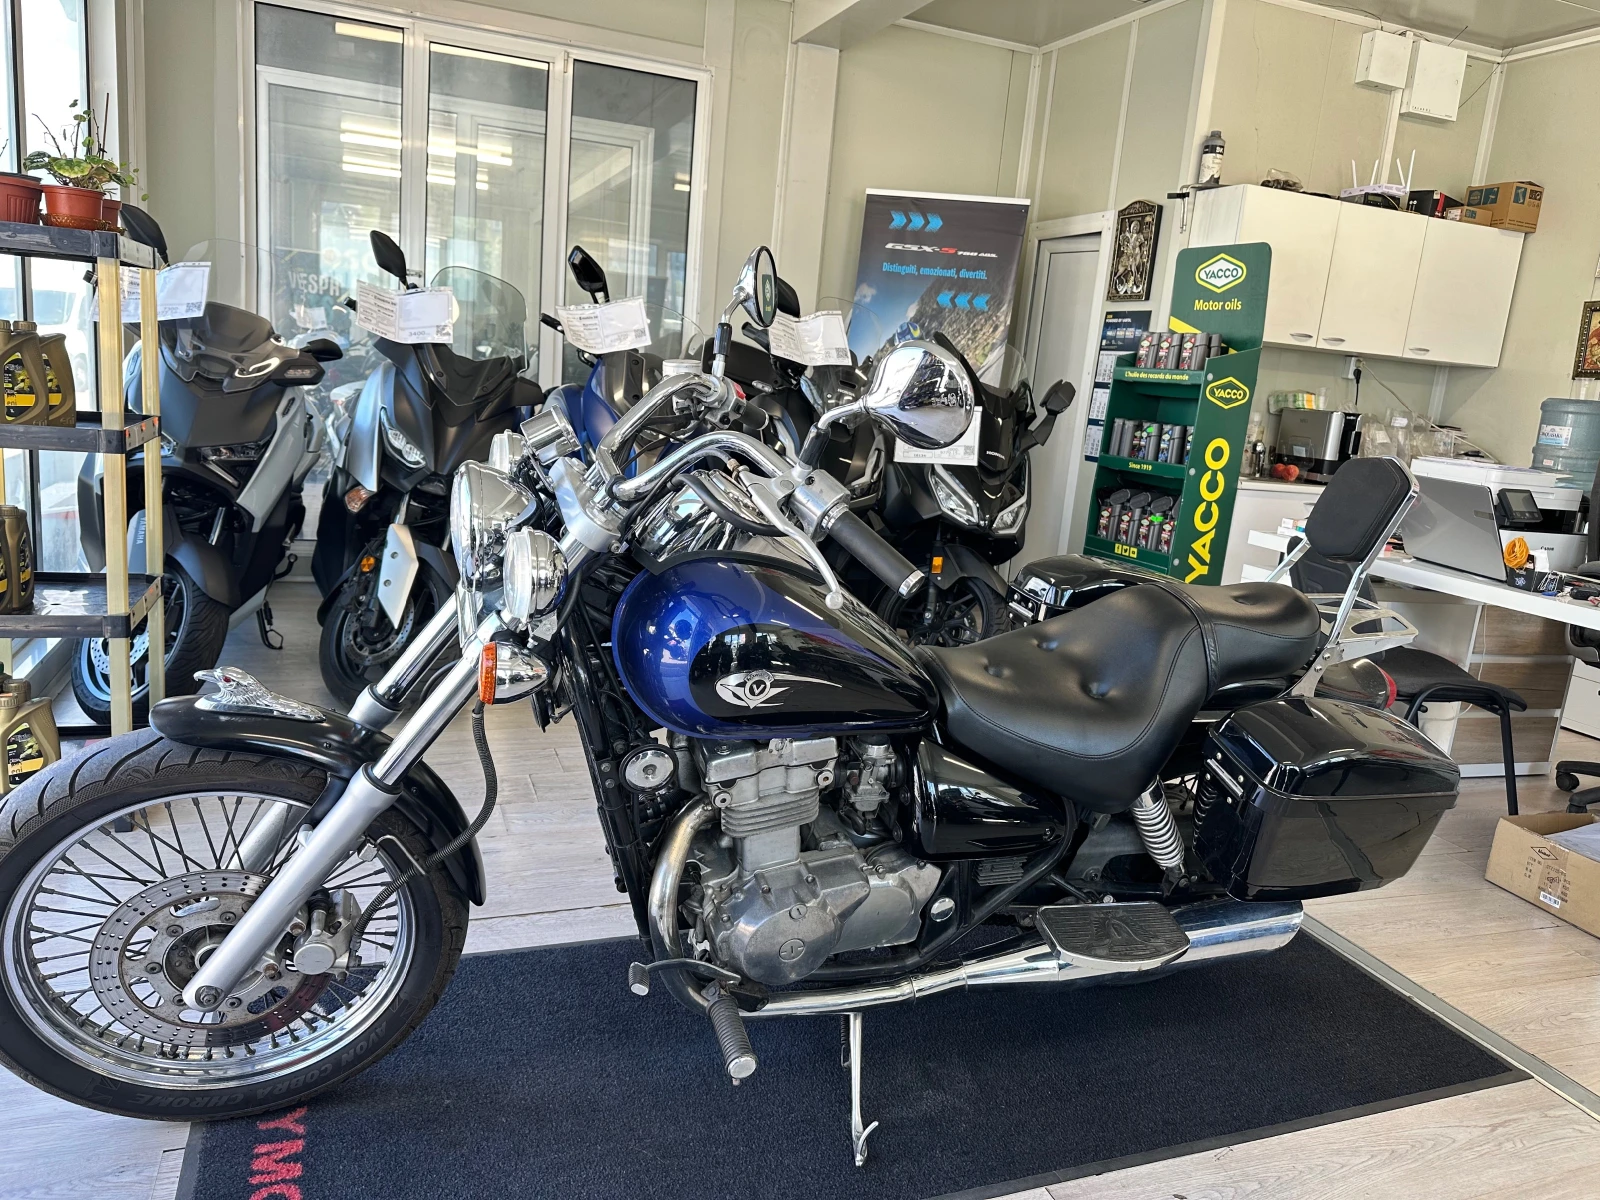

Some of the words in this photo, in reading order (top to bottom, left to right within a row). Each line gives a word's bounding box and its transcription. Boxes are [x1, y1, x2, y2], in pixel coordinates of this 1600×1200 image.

[882, 262, 918, 275] Distinguiti,
[920, 267, 958, 279] emozionati,
[959, 268, 988, 280] divertiti.
[1204, 268, 1239, 279] YACCO
[1194, 299, 1224, 311] Motor
[1224, 298, 1242, 310] oils
[1213, 387, 1244, 400] YACCO
[1128, 461, 1140, 469] Since
[1141, 463, 1152, 471] 1919
[1184, 437, 1231, 584] YACCO
[751, 683, 766, 696] V
[341, 1021, 387, 1067] AVON
[256, 1063, 333, 1099] COBRA
[128, 1092, 245, 1108] CHROME
